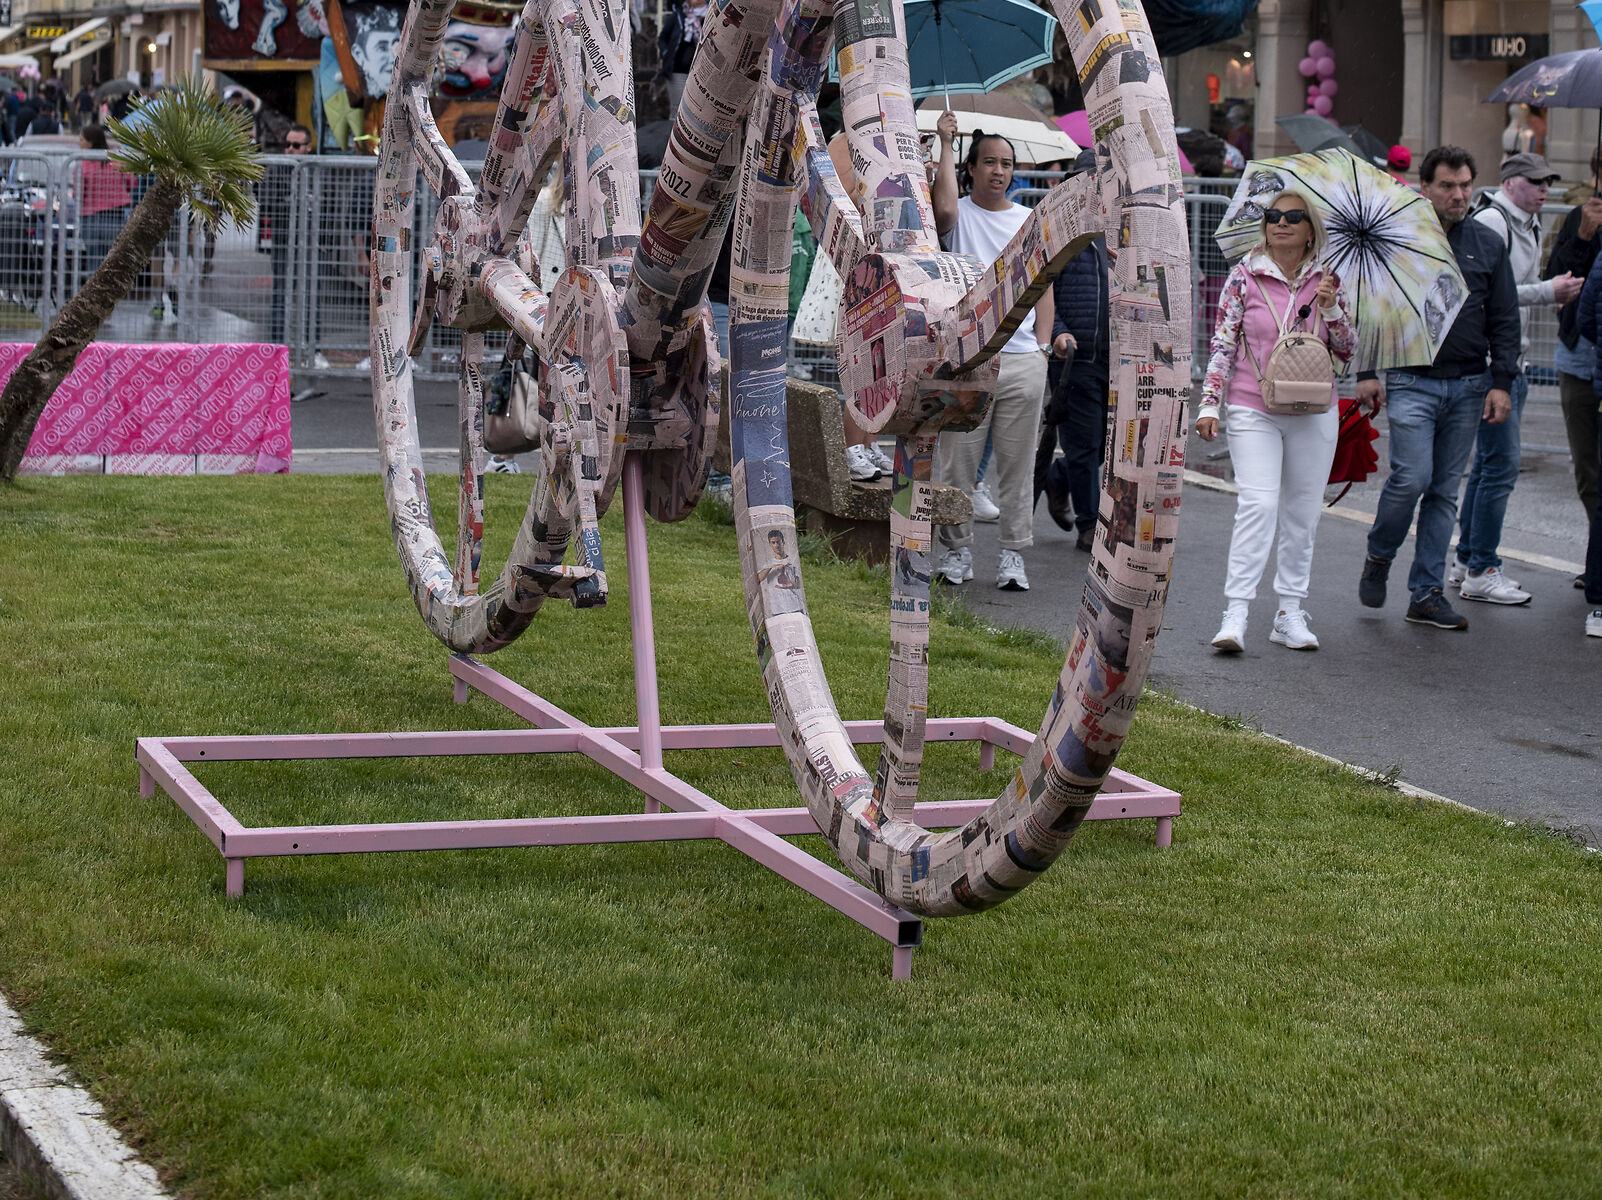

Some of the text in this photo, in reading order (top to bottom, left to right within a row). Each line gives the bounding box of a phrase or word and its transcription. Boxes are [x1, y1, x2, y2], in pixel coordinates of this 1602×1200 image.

[592, 54, 612, 80] Sport
[1080, 32, 1132, 85] Innamor
[742, 145, 753, 173] Sport
[665, 166, 692, 199] 2022
[1138, 364, 1147, 374] LA
